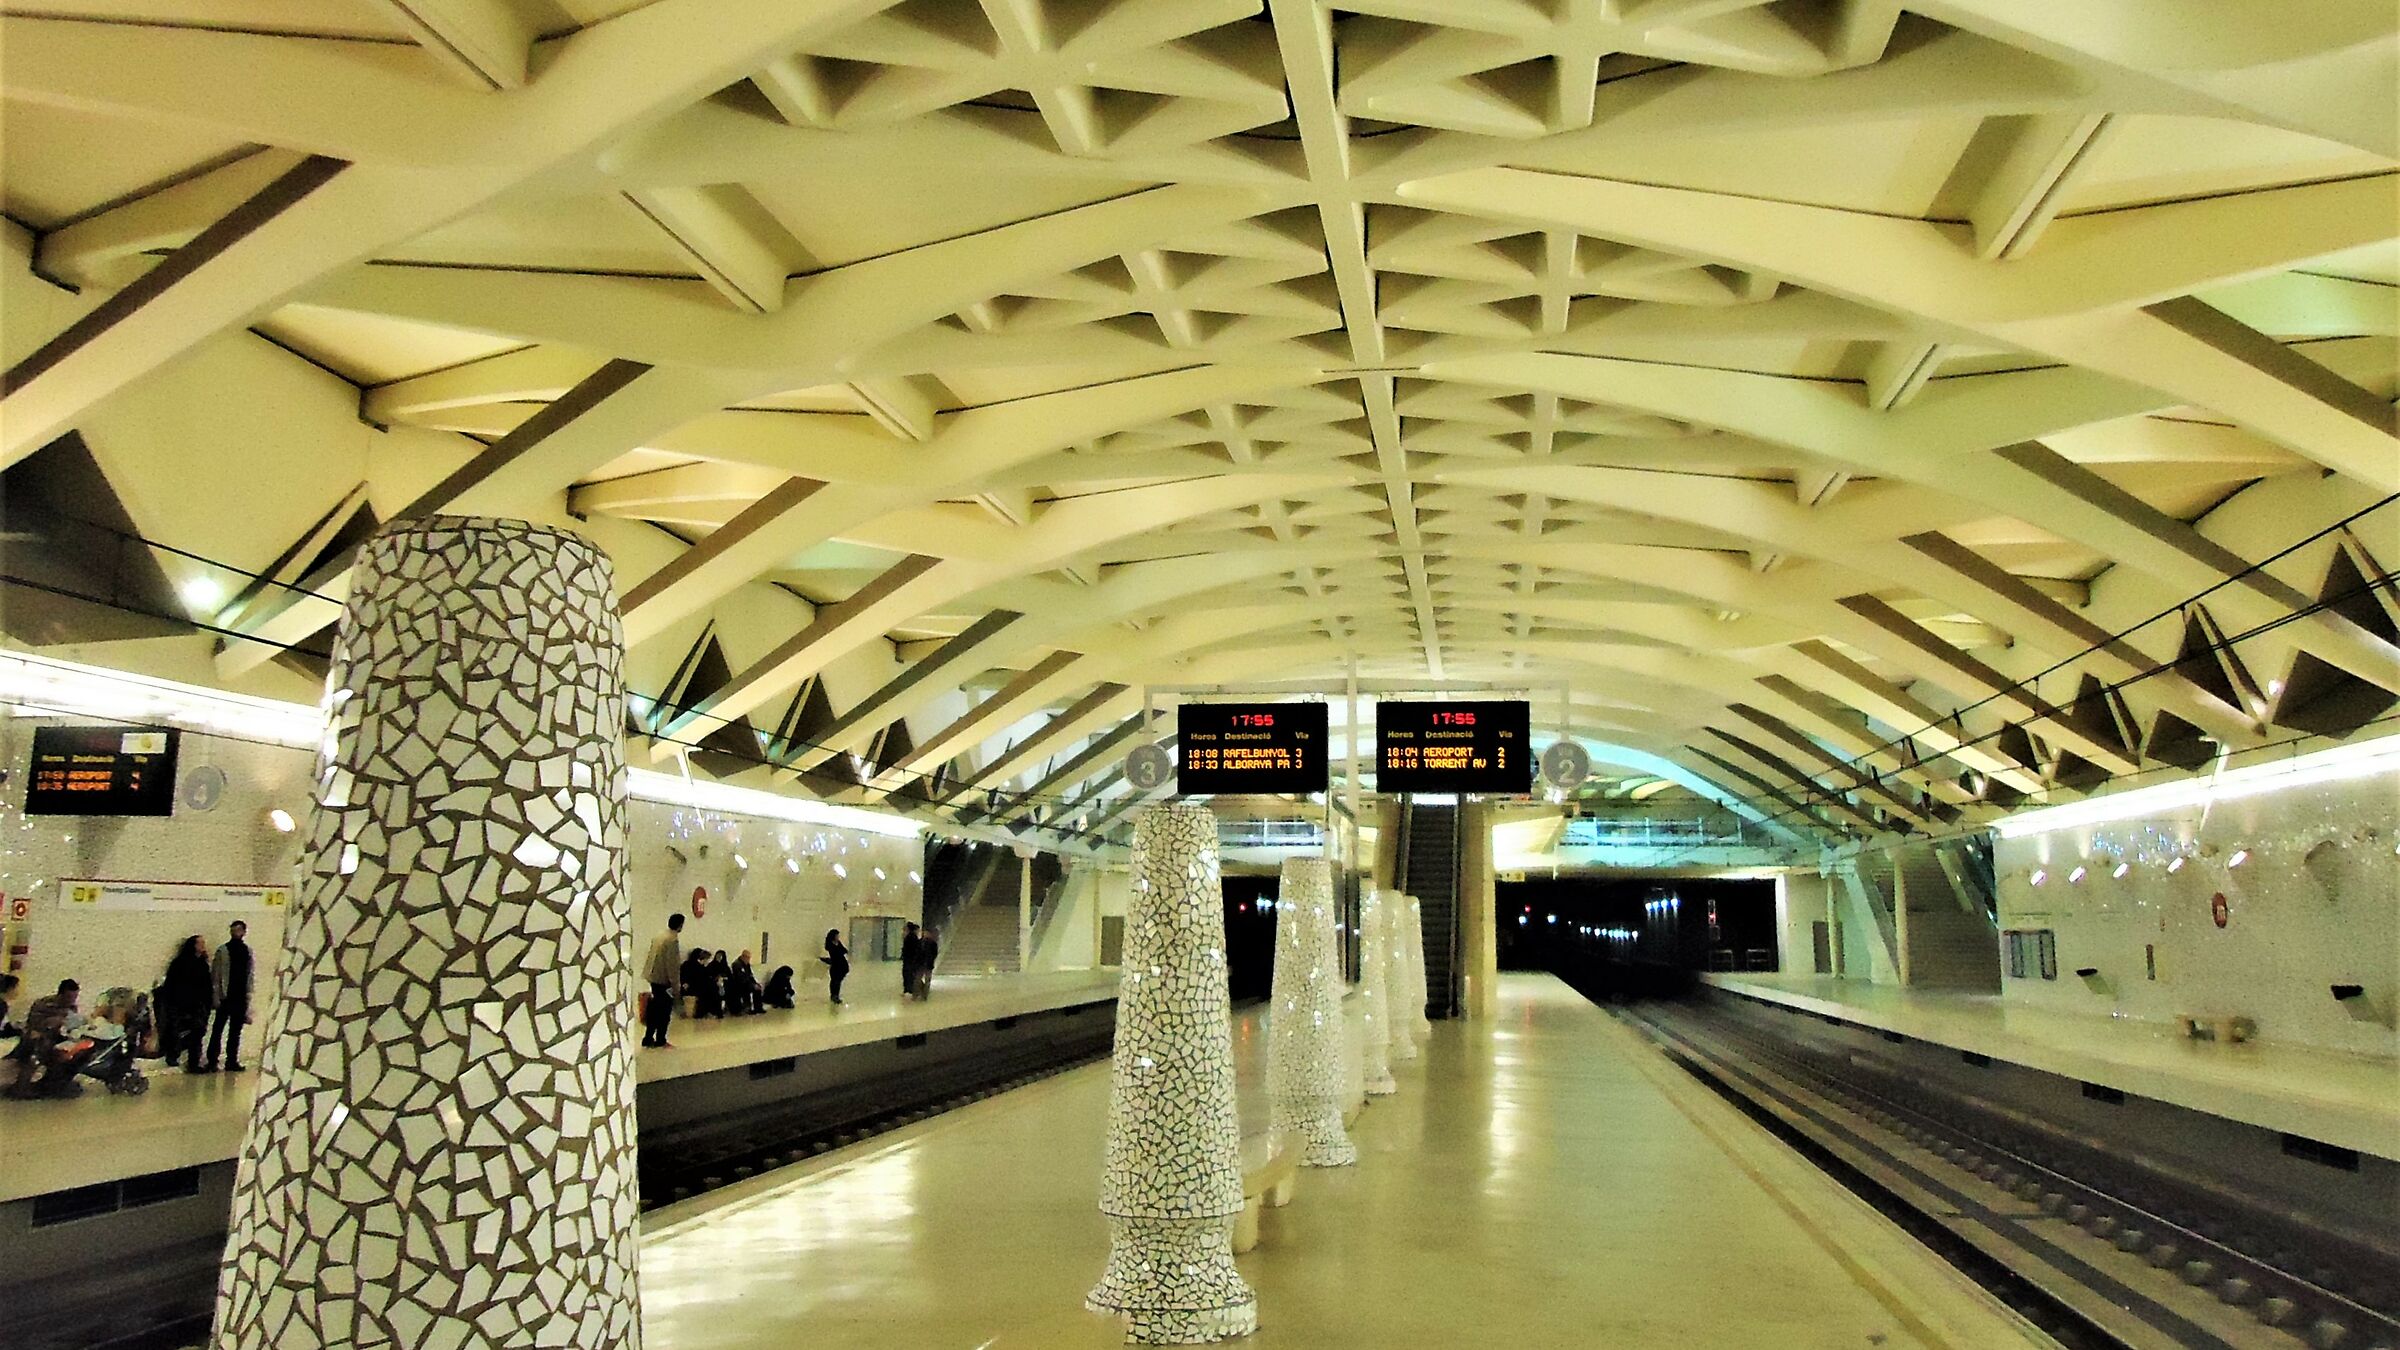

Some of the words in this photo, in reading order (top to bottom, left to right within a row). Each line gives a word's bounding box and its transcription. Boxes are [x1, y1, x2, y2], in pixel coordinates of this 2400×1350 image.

[1232, 714, 1274, 726] 17:55
[1432, 712, 1476, 725] 17:55
[1224, 731, 1272, 740] Destinació
[1425, 730, 1474, 739] Destinació
[1188, 749, 1218, 758] 18:08
[1223, 748, 1290, 758] RAFELBUNYOL
[1295, 748, 1303, 758] 3
[1387, 747, 1418, 757] 18:04
[1423, 747, 1474, 757] AEROPORT
[1497, 747, 1505, 757] 2
[1188, 760, 1218, 769] 18:33
[1223, 760, 1272, 769] ALBORAYA
[1277, 760, 1290, 769] PA
[1295, 760, 1303, 769] 3
[1387, 758, 1418, 768] 18:16
[1423, 758, 1468, 768] TORRENT
[1472, 758, 1487, 768] AV
[1497, 758, 1505, 768] 2
[1140, 761, 1156, 785] 3
[1559, 759, 1576, 783] 2
